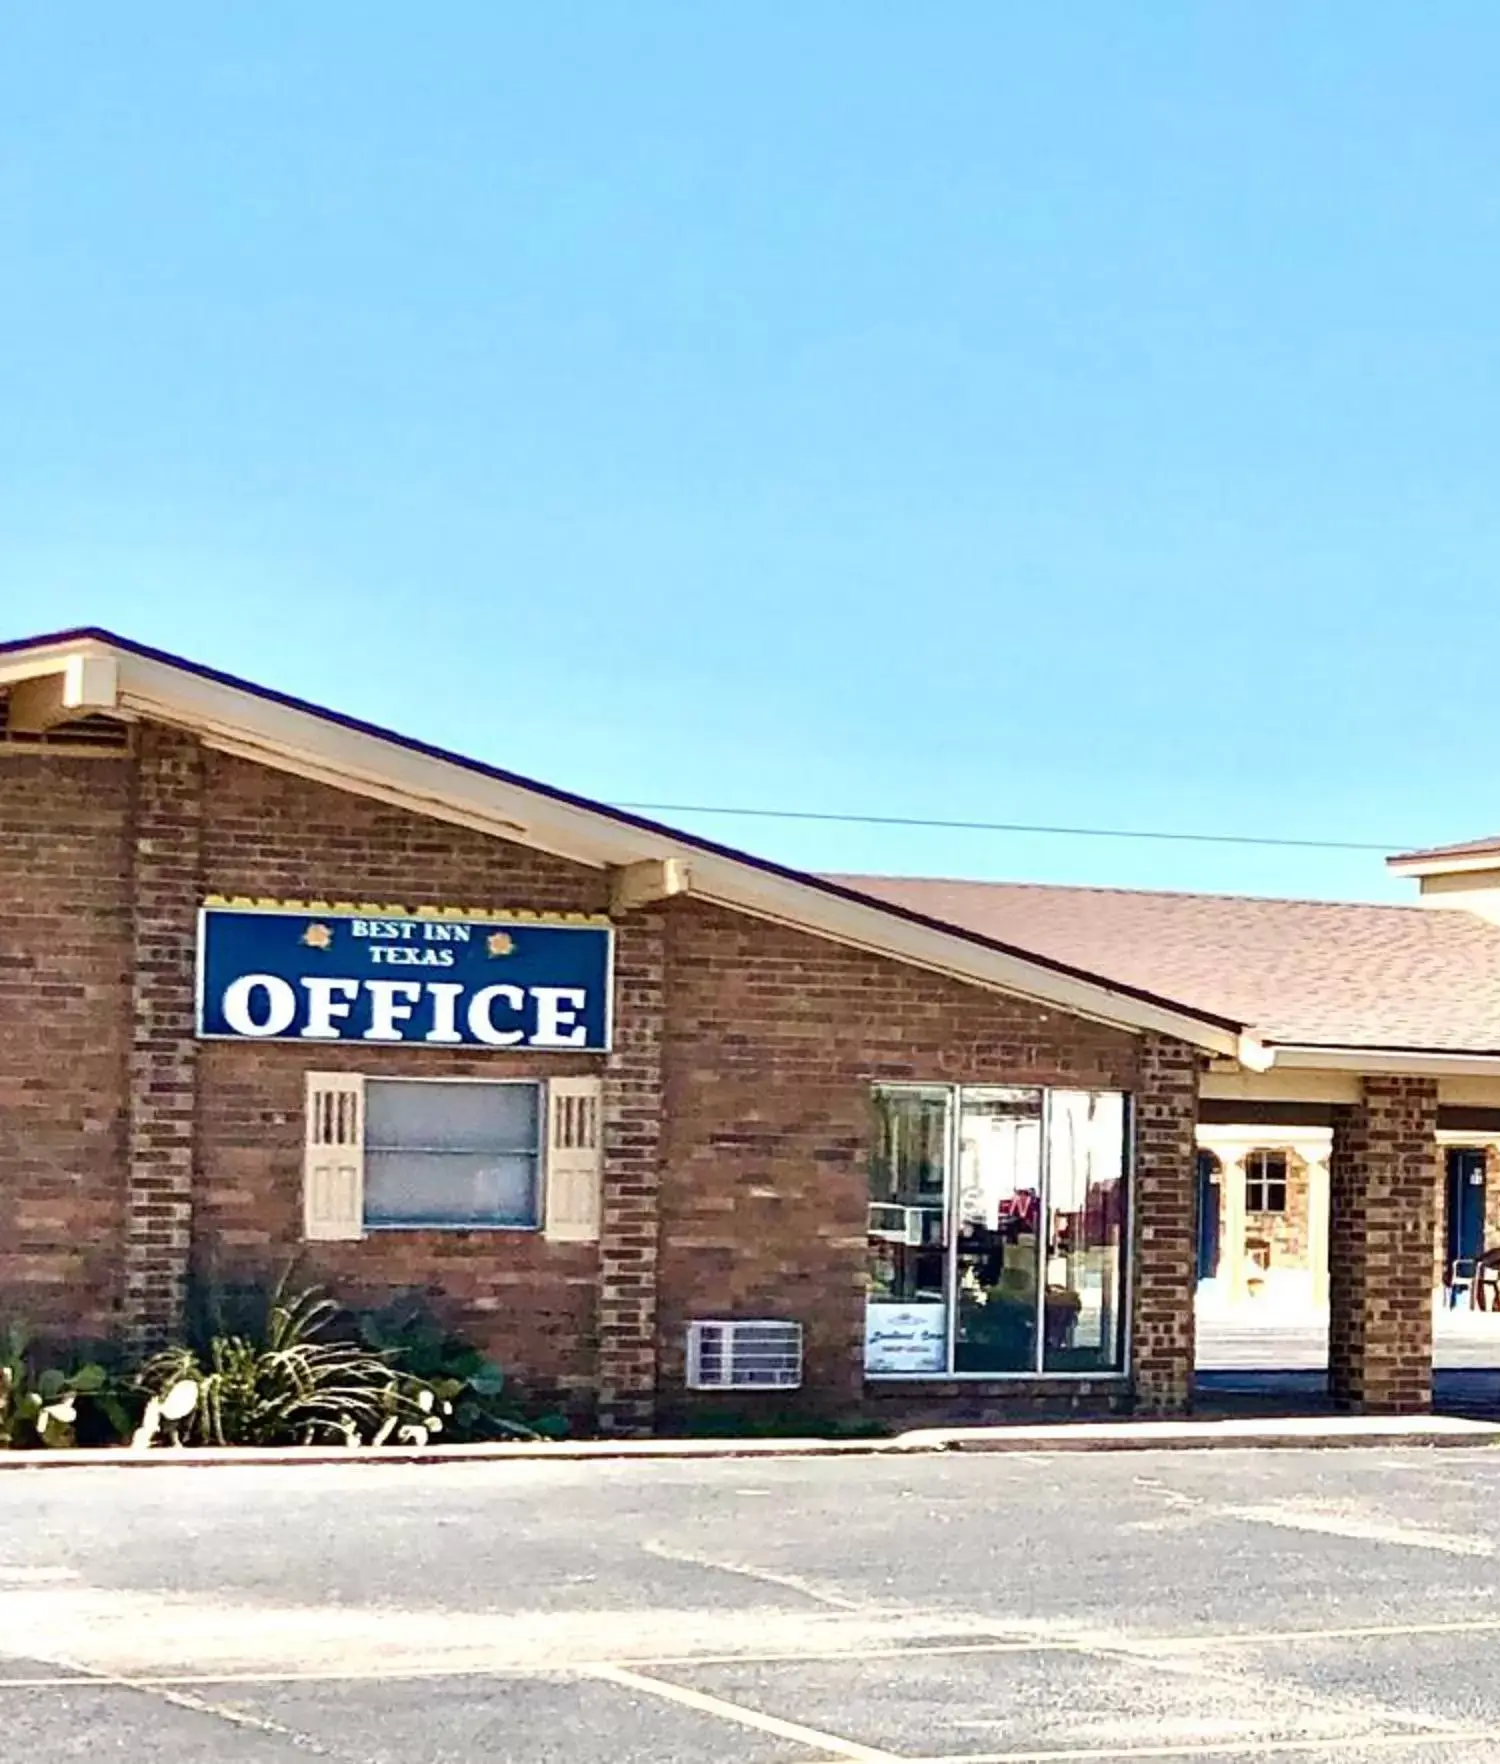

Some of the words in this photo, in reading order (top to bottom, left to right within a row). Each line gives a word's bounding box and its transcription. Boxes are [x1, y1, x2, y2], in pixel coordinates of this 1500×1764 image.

[352, 920, 417, 939] BEST
[424, 923, 472, 942] INN
[368, 946, 455, 967] TEXAS
[221, 974, 587, 1047] OFFICE
